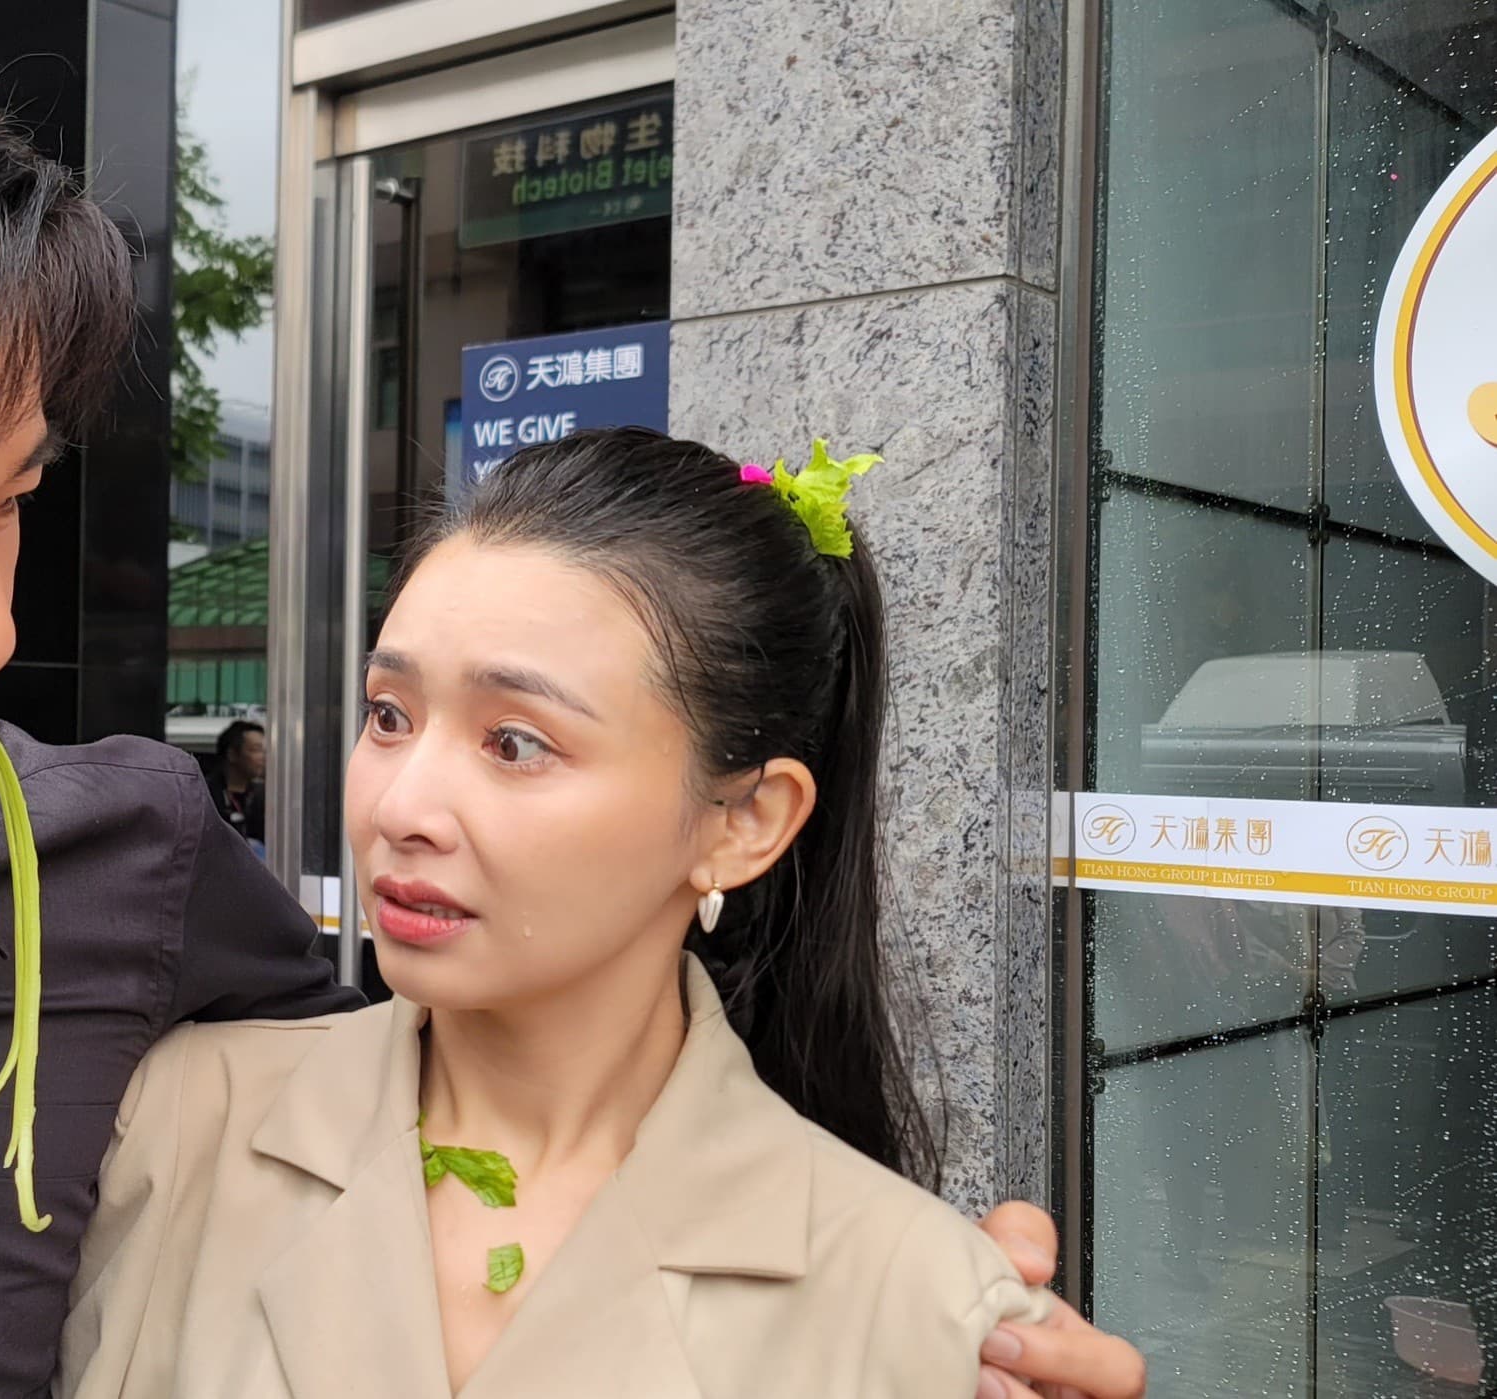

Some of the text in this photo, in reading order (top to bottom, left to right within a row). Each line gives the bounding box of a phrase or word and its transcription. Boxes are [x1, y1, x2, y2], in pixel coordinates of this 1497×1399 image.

[526, 342, 644, 391] 天鴻集團
[474, 411, 577, 447] WE GIVE
[1149, 815, 1273, 856] 天鴻集團
[1082, 863, 1276, 887] TIAN HONG GROUP LIMITED
[1347, 880, 1493, 900] TIAN HONG GROUP
